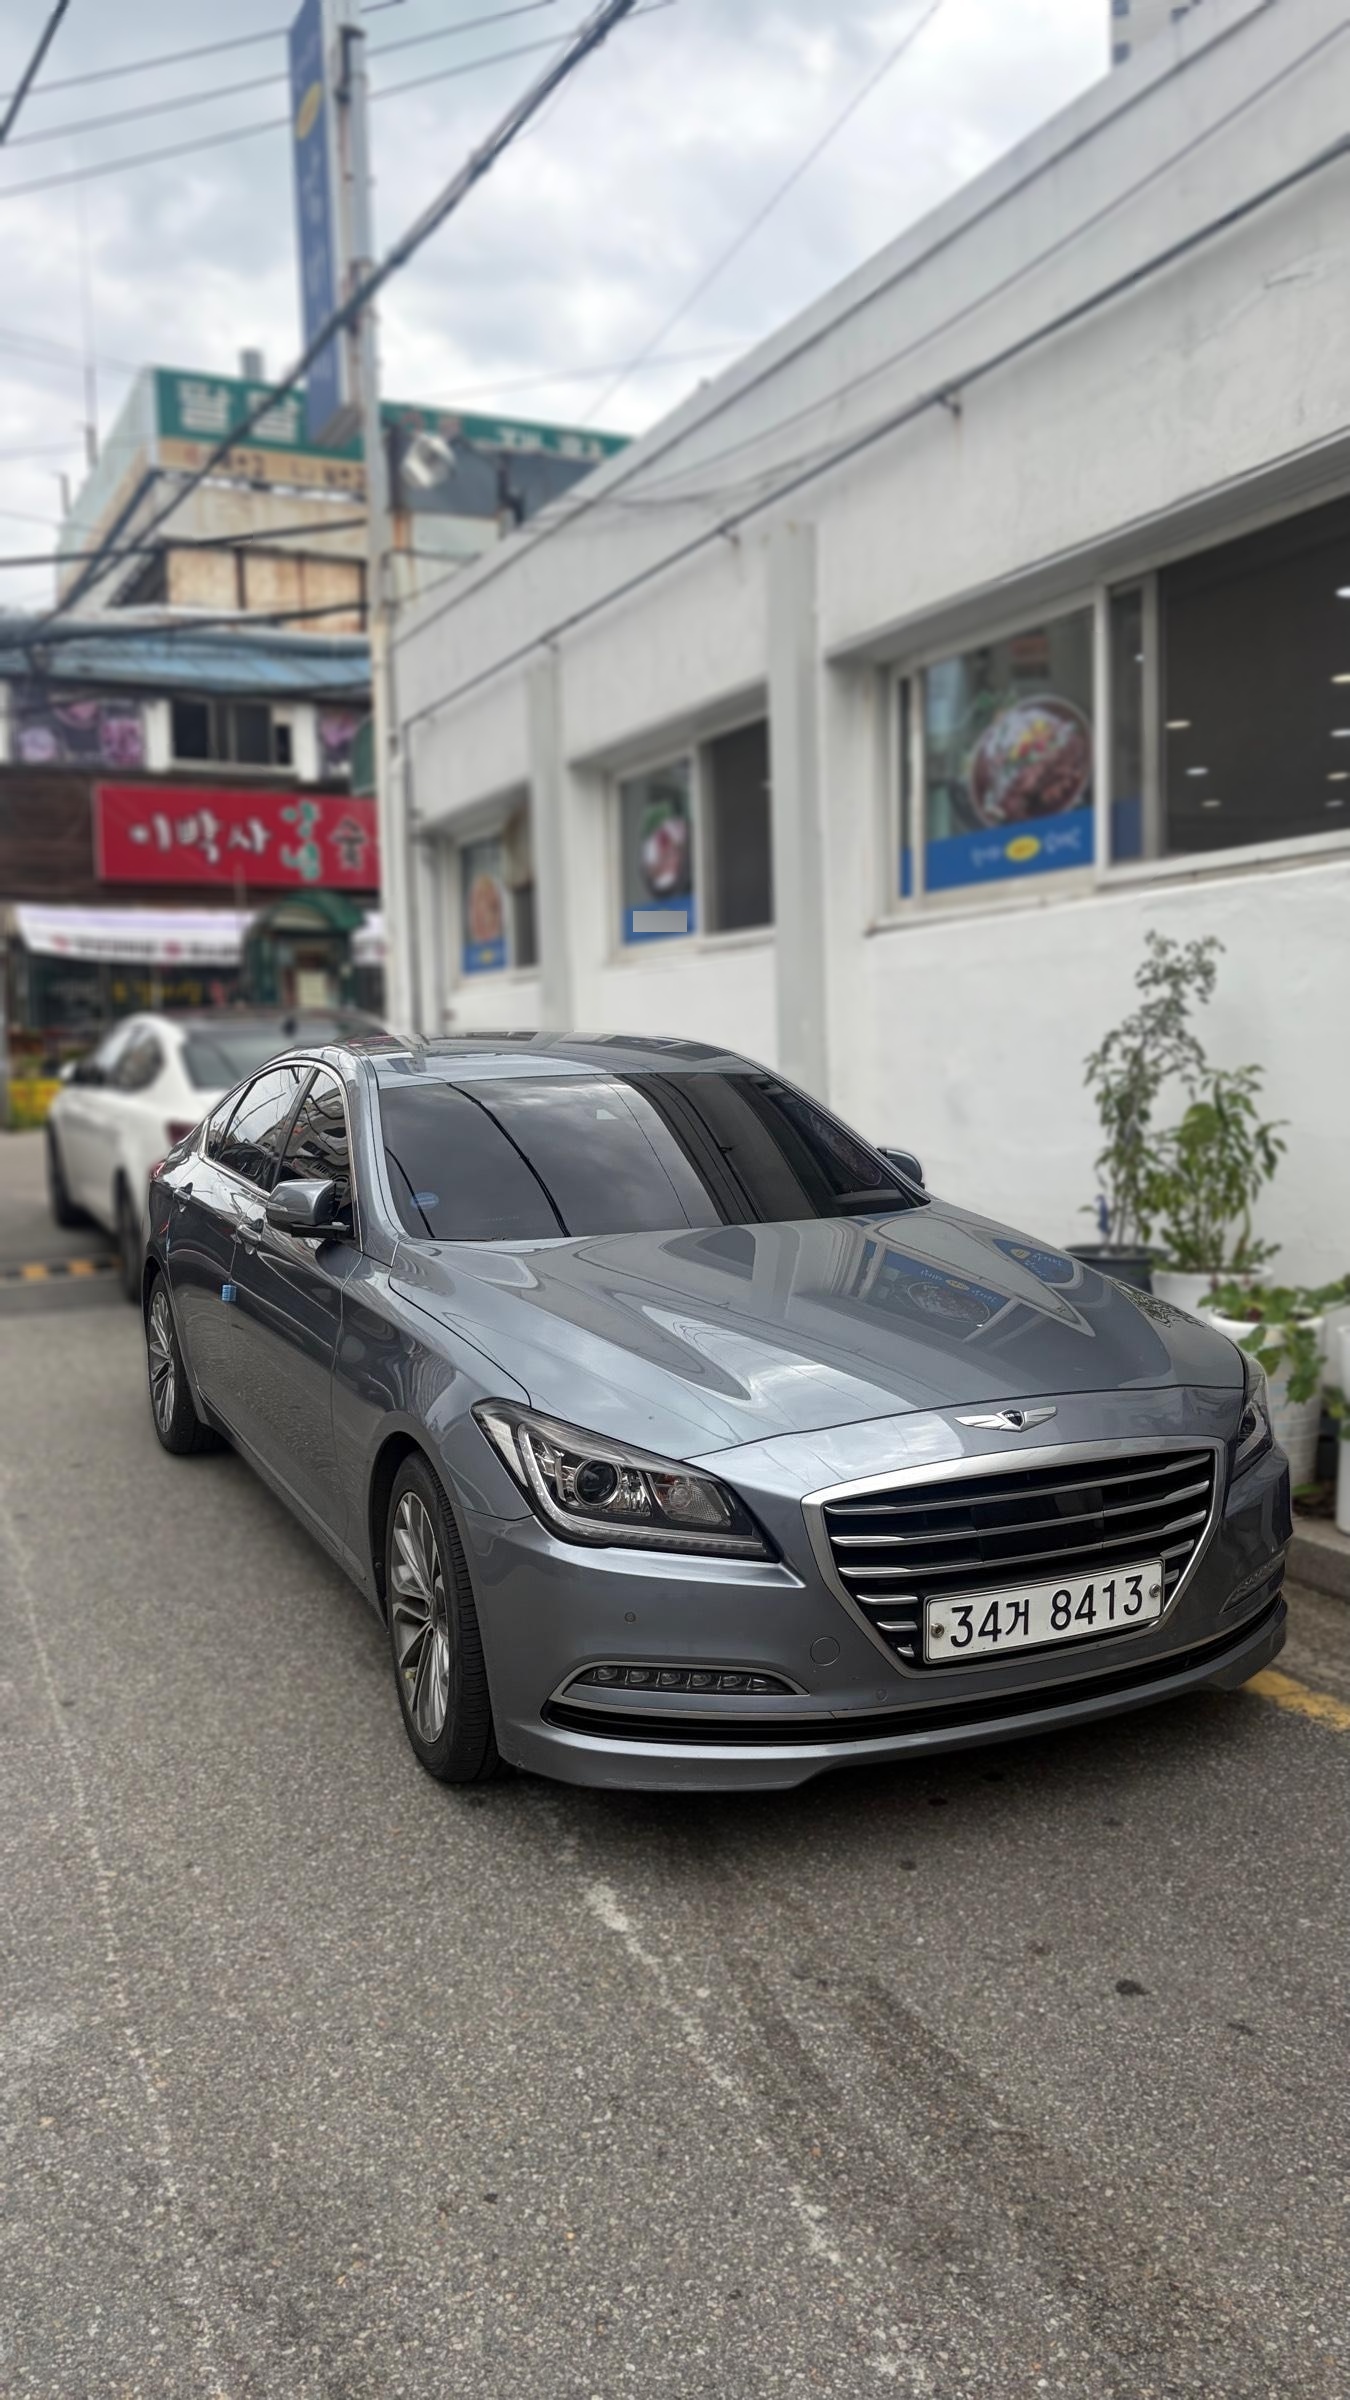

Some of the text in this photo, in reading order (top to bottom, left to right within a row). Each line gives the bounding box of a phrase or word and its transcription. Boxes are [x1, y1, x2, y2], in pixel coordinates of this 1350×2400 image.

[127, 808, 271, 864] 이박사
[949, 1574, 1144, 1648] 34거 8413
